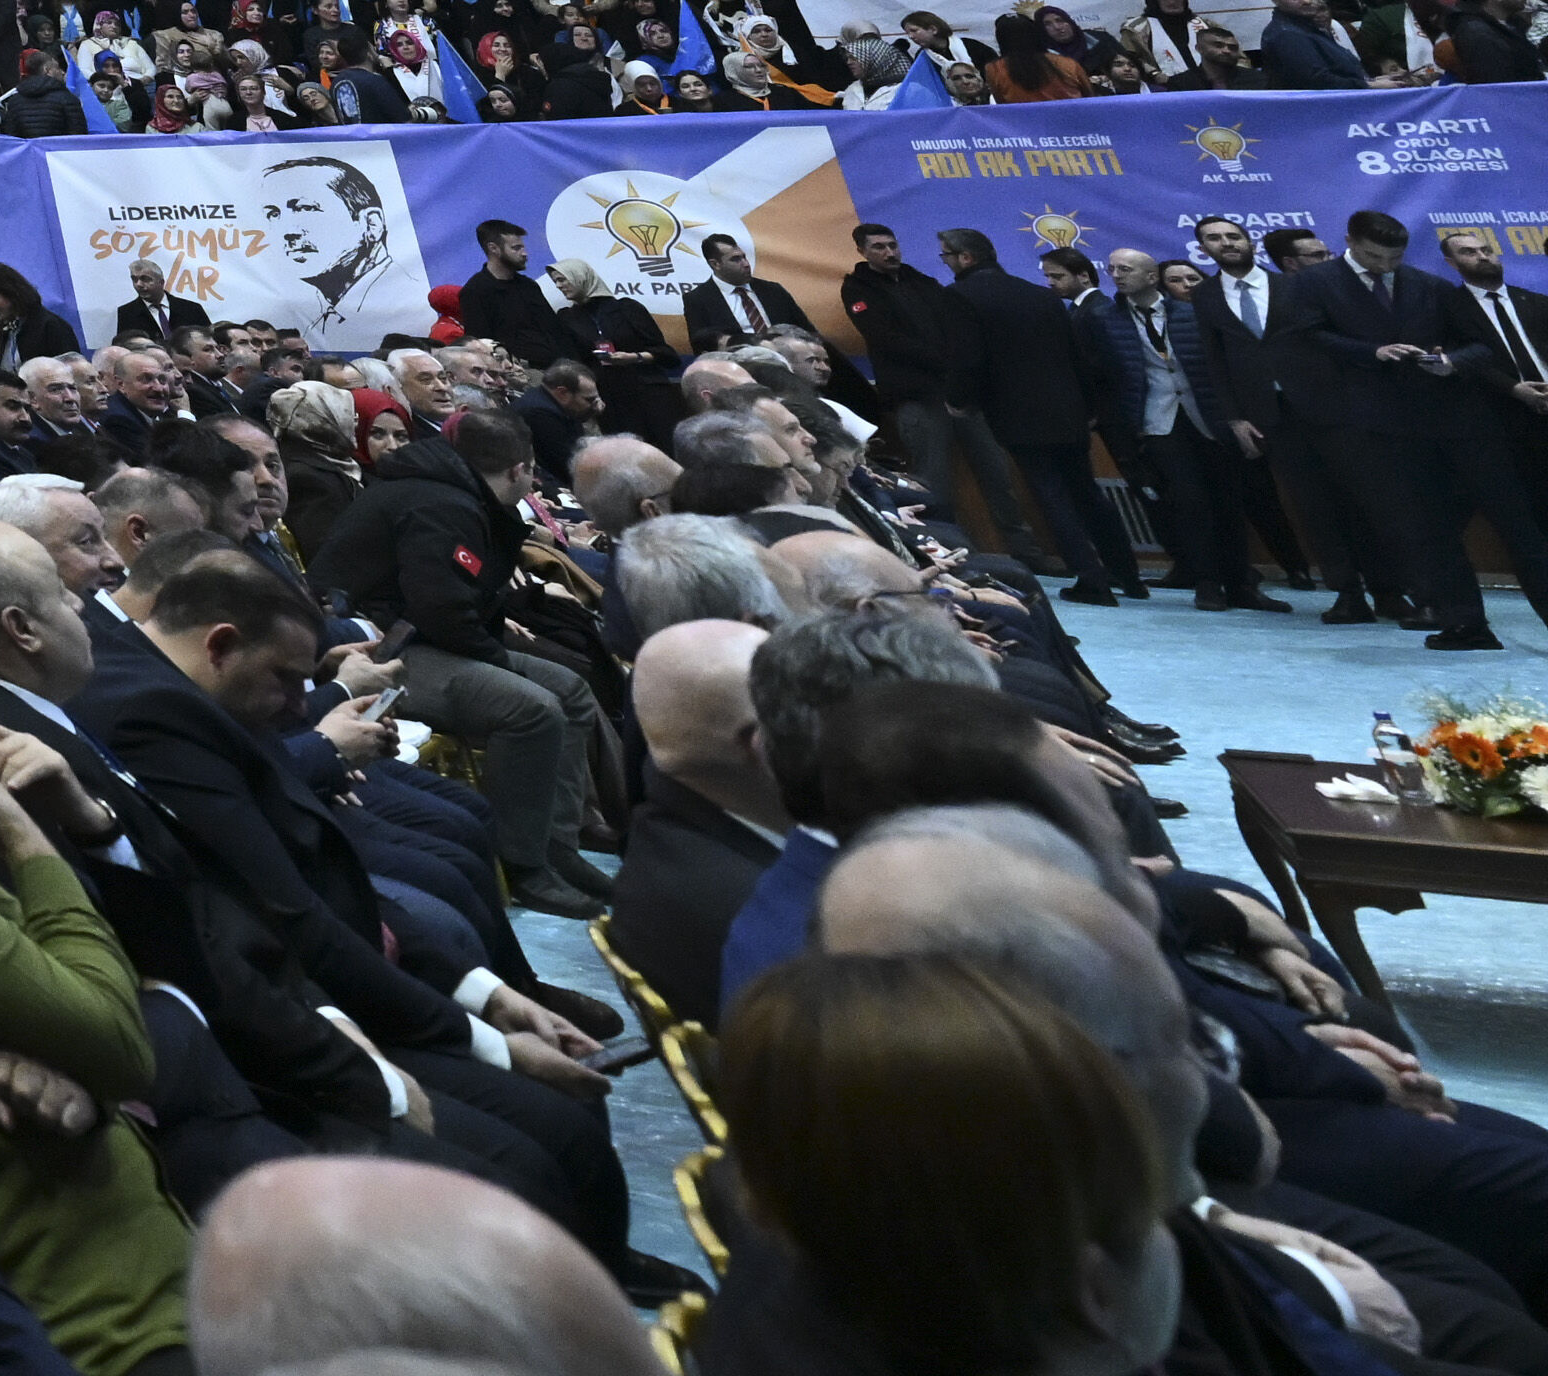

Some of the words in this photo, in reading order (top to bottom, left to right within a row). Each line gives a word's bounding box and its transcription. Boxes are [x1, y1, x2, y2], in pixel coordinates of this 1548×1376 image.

[1347, 123, 1392, 138] AK
[1394, 137, 1450, 148] ORDU
[1392, 147, 1504, 163] OLAĞAN
[975, 151, 1022, 178] AK
[1202, 174, 1225, 183] AK
[90, 225, 270, 260] SÖZÜMÜZ
[614, 282, 645, 296] AK
